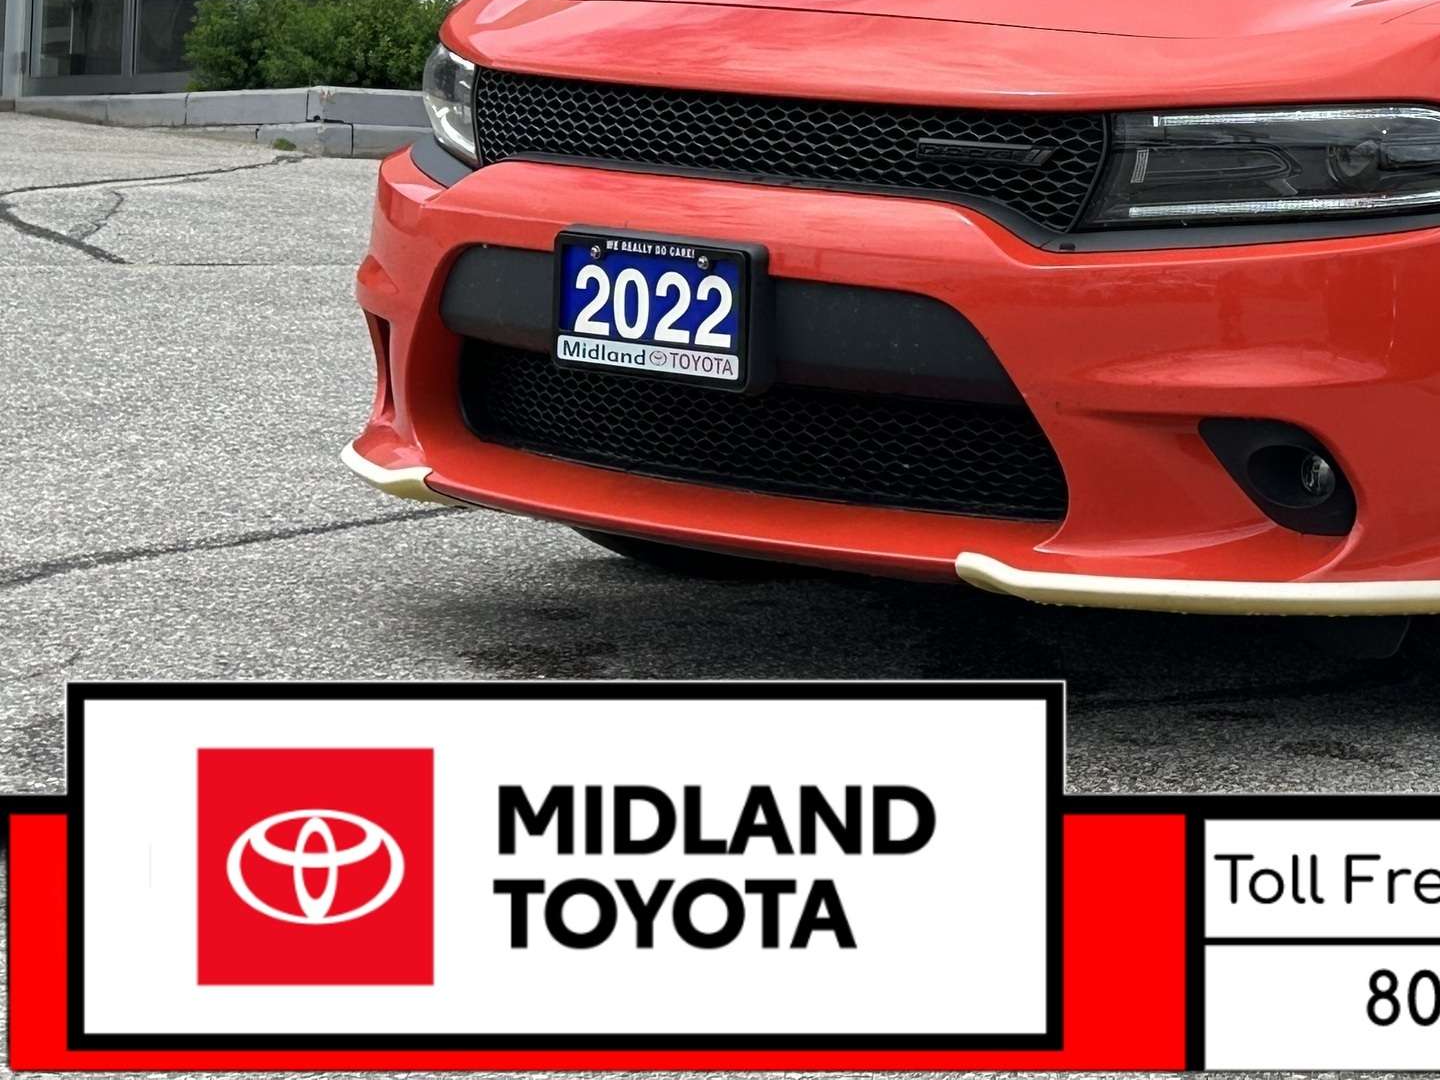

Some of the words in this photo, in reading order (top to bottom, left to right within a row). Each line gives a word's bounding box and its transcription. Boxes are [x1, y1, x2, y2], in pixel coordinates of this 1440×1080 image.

[606, 240, 618, 251] WE
[621, 241, 652, 254] REALLY
[655, 245, 667, 256] DO
[669, 247, 695, 259] CARE!
[574, 264, 733, 348] 2022
[562, 340, 646, 366] Midland
[669, 352, 734, 376] TOYOTA
